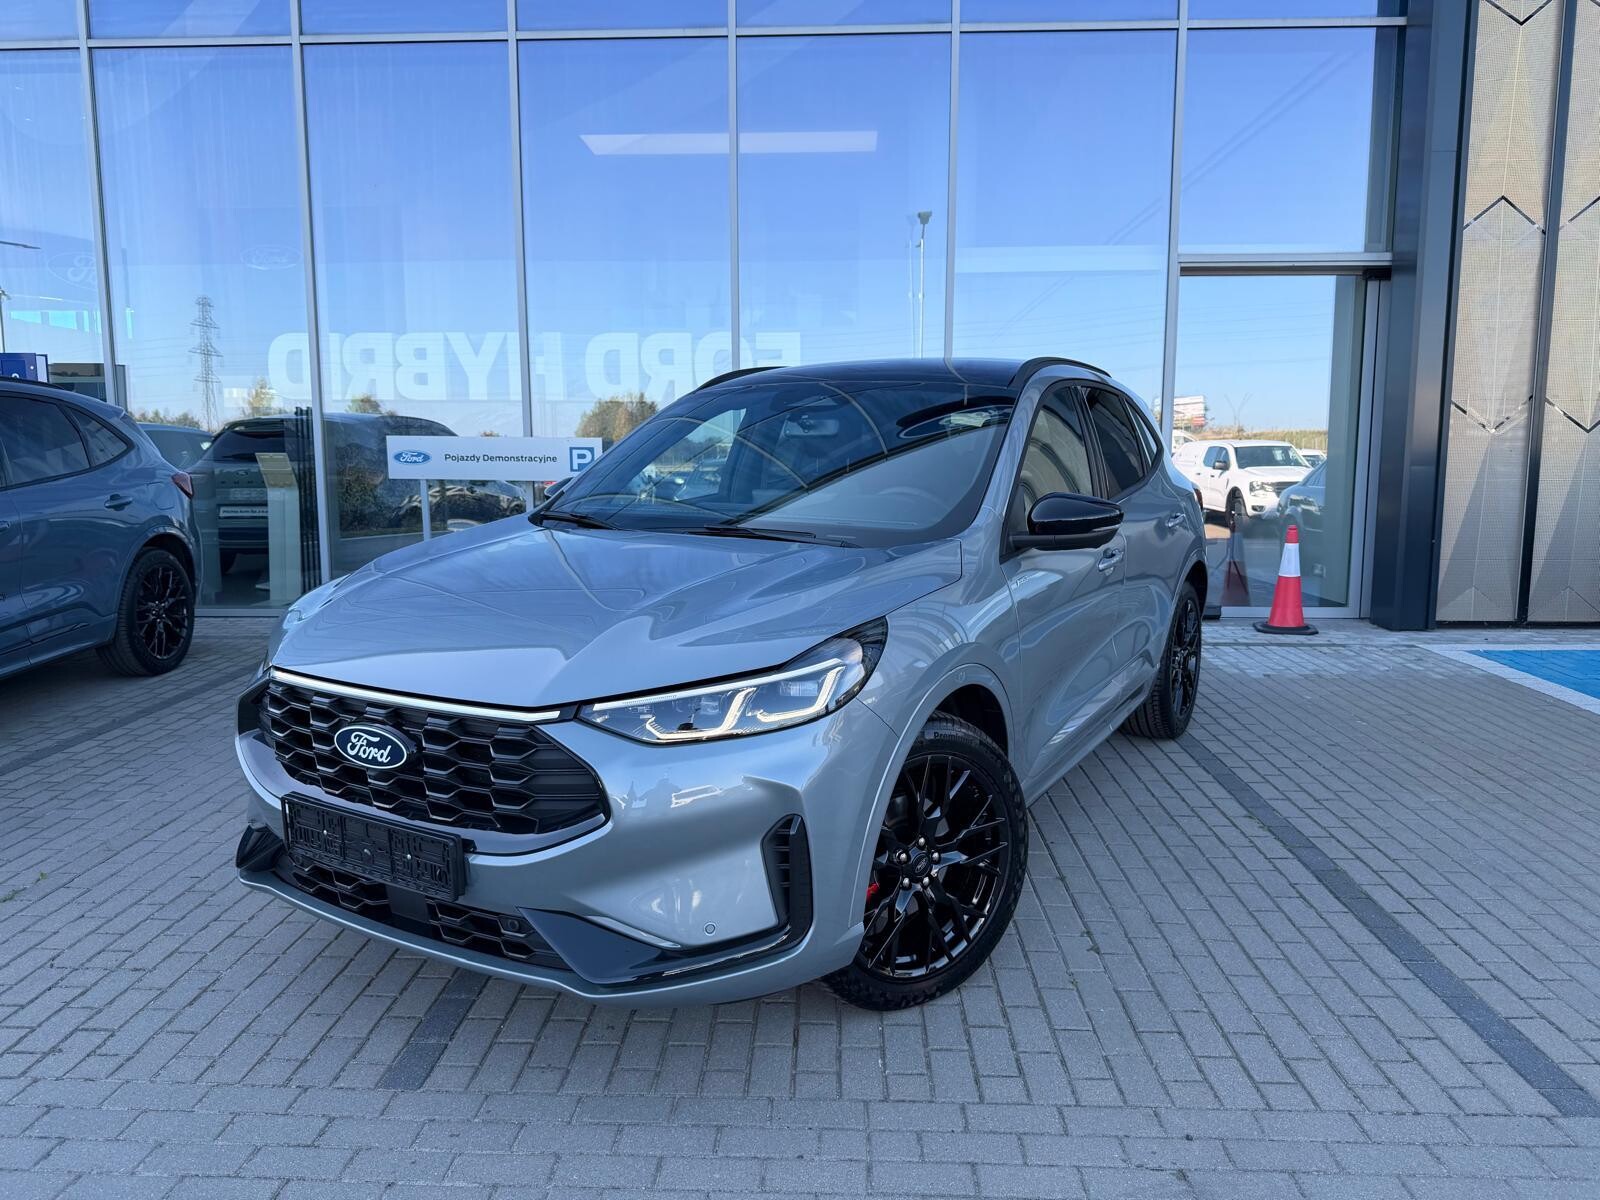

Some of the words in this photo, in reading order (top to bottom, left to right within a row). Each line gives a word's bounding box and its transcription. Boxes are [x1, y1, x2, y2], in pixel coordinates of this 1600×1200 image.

[400, 451, 424, 463] Ford
[444, 453, 480, 463] Pojazdy
[482, 454, 557, 463] Demonstracyjne
[572, 449, 591, 470] P
[346, 731, 392, 763] Ford
